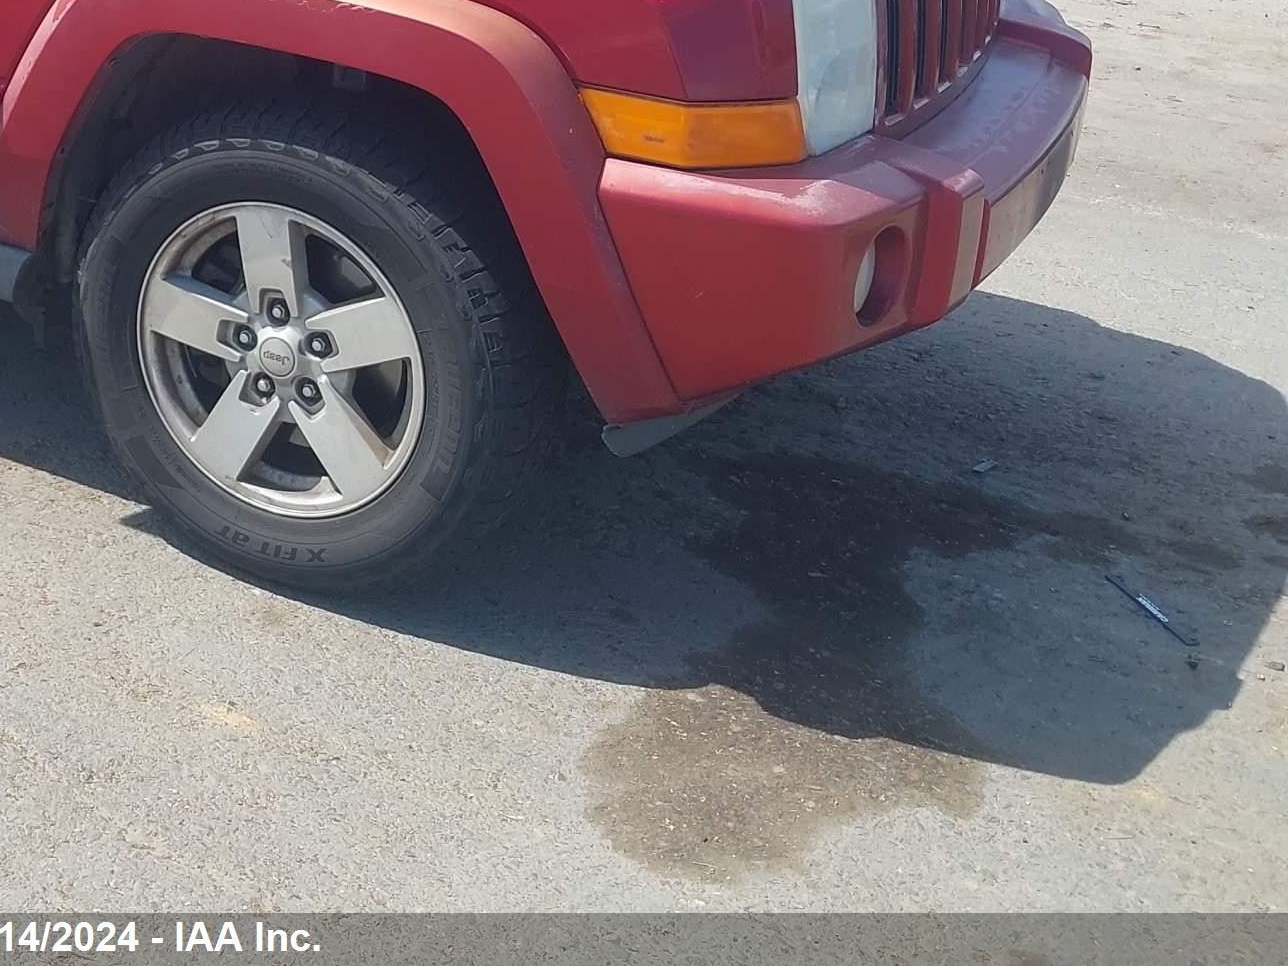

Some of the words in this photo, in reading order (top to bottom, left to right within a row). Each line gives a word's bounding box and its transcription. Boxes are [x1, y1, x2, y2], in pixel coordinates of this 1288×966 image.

[263, 349, 291, 366] Jeep
[253, 541, 299, 561] FIT
[305, 547, 328, 563] X
